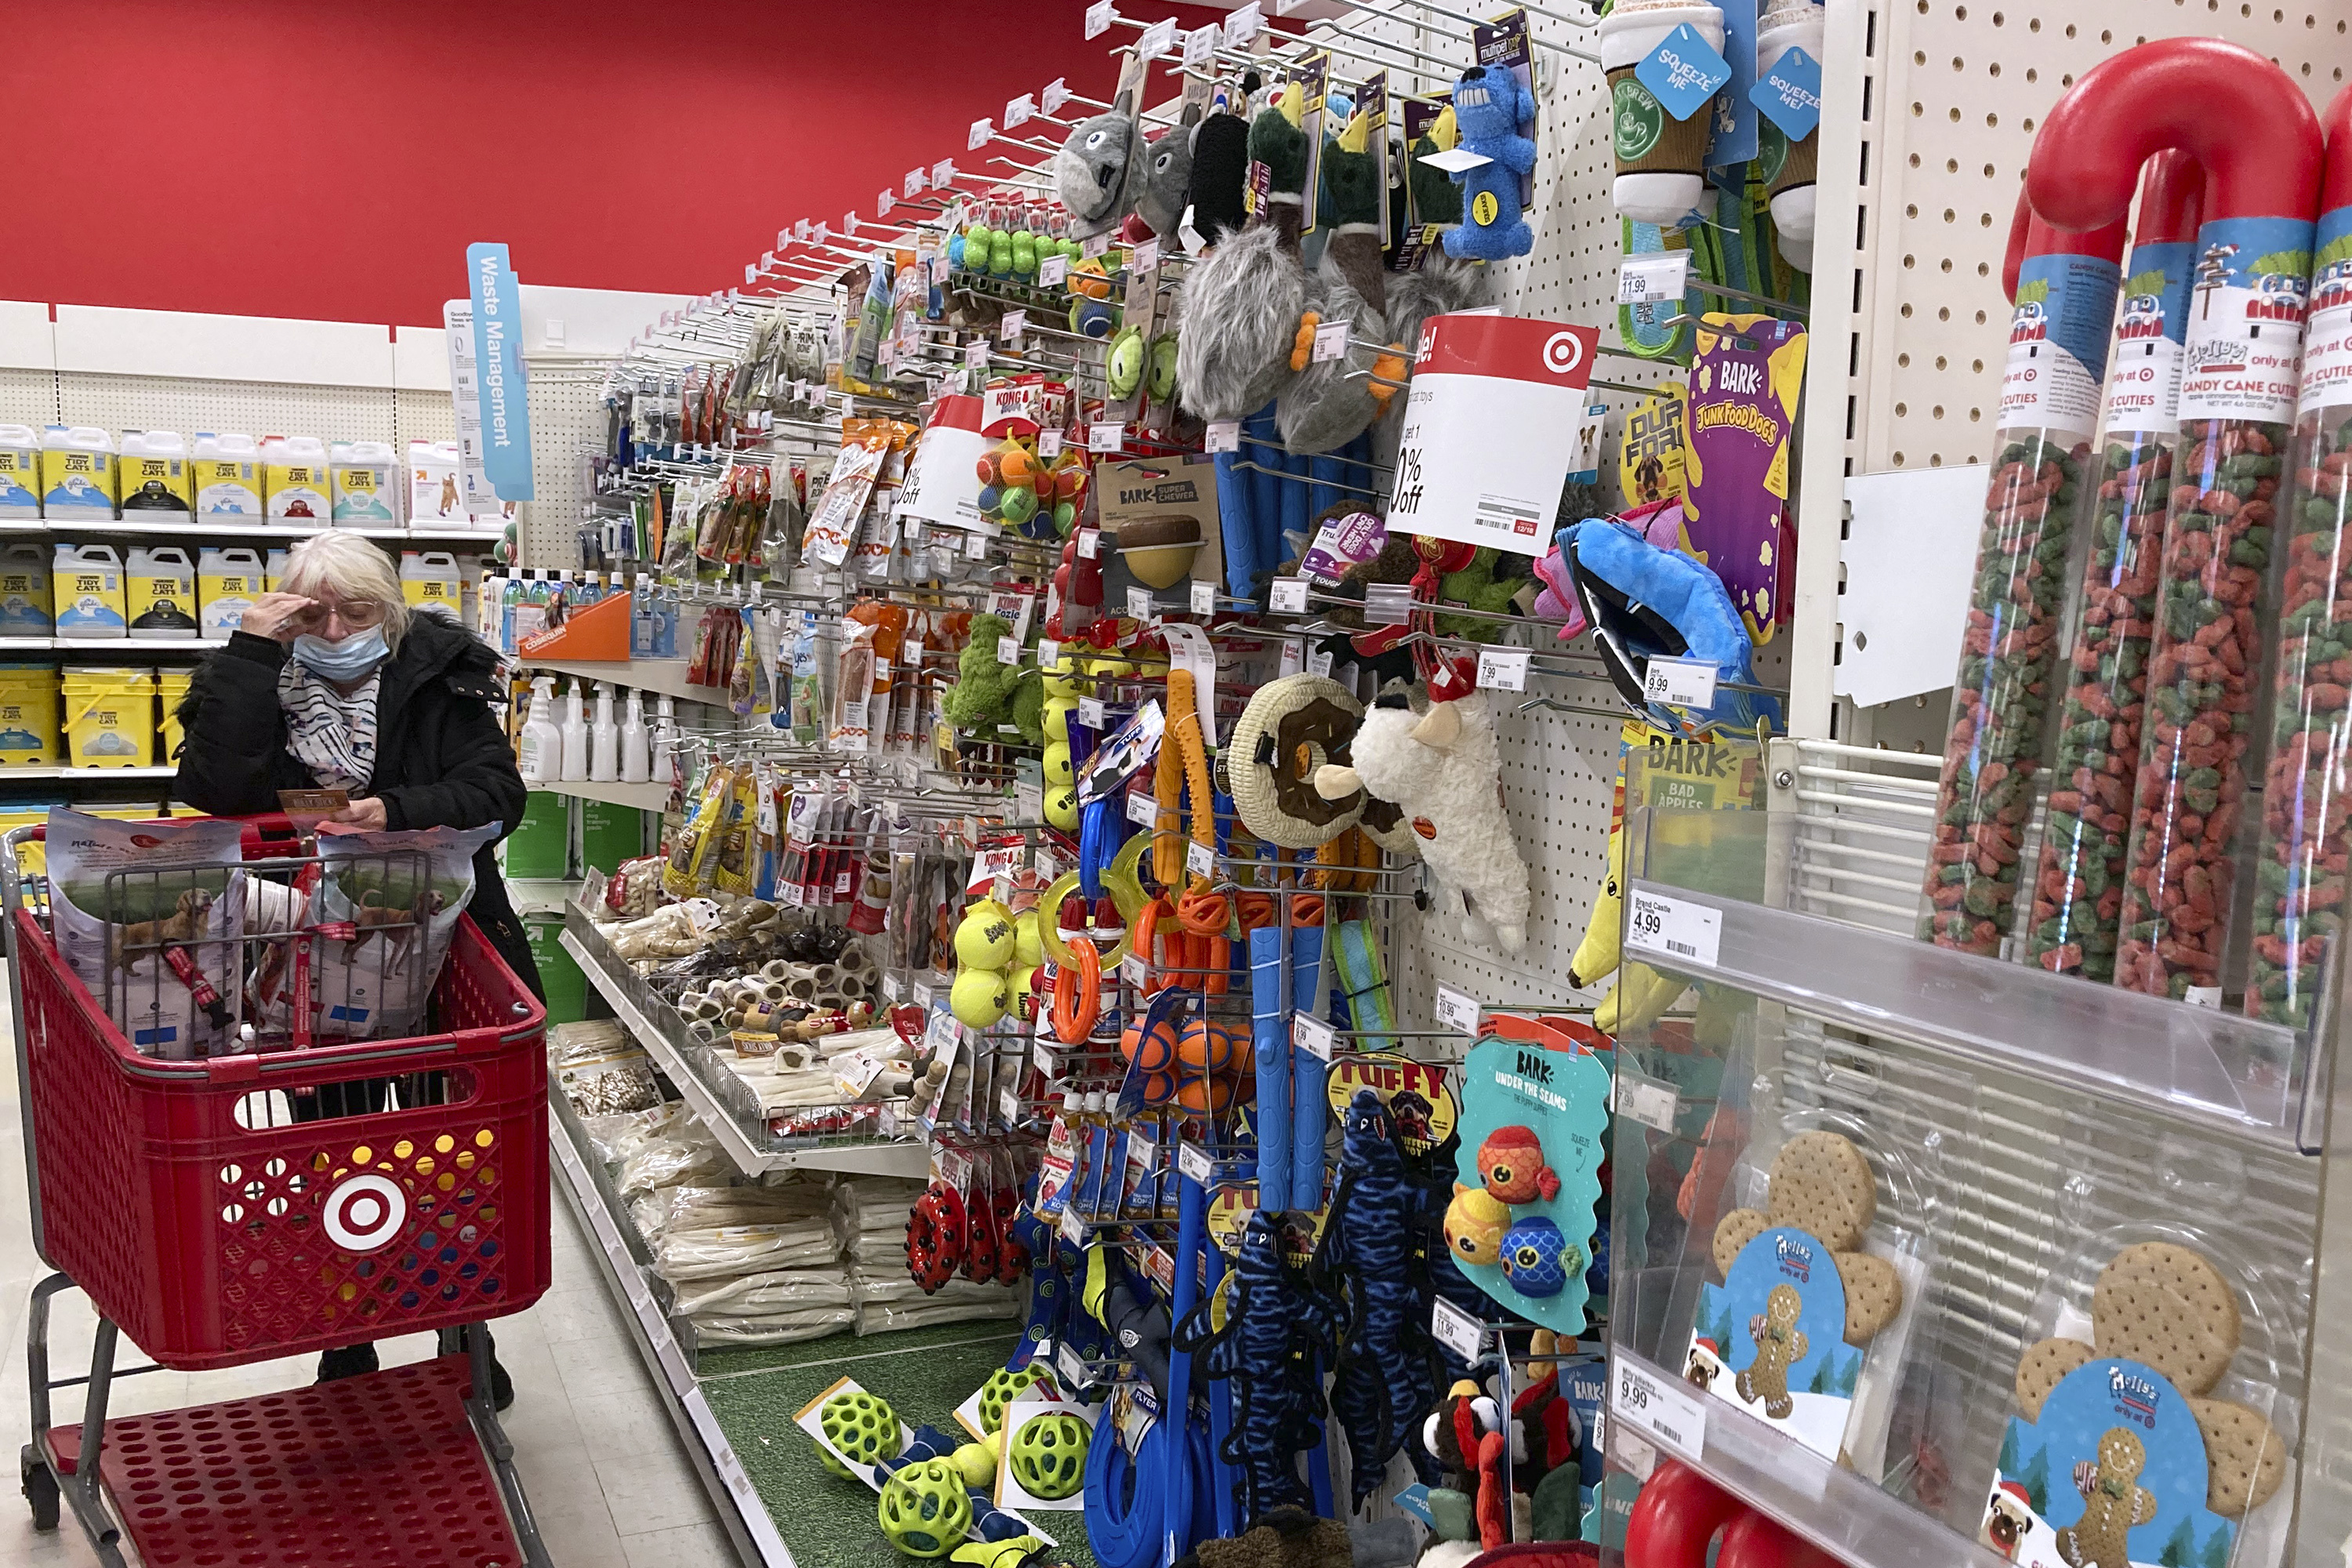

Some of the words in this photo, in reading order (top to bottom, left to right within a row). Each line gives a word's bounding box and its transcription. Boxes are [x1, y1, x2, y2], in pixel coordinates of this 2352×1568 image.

[1658, 48, 1713, 93] SQUEEZE
[1627, 85, 1655, 111] BREW
[1769, 74, 1821, 110] SQUEEZE
[480, 256, 501, 316] Waste
[1623, 279, 1646, 294] 11.99
[2327, 339, 2339, 351] at
[2252, 356, 2278, 368] only
[2281, 358, 2291, 368] at
[485, 321, 511, 448] Management
[1720, 360, 1760, 395] BARK
[2013, 372, 2021, 381] at
[2125, 371, 2136, 380] at
[2183, 379, 2221, 393] CANDY
[2223, 379, 2264, 393] CANE
[996, 390, 1022, 406] KONG
[1420, 390, 1434, 406] toys
[2005, 393, 2037, 405] CUTIES
[2117, 394, 2154, 406] CUTIES
[1630, 398, 1684, 441] DUR
[1625, 424, 1683, 467] FOR
[1390, 447, 1423, 514] 0%
[902, 488, 921, 505] off
[1120, 487, 1153, 505] BARK
[1157, 484, 1186, 495] SUPER
[1158, 491, 1195, 502] CHEWER
[1399, 485, 1424, 514] off
[1516, 524, 1534, 534] 12/18
[524, 626, 568, 652] COSEQUIN
[1482, 666, 1497, 679] 7.99
[1648, 677, 1668, 692] 9.99
[1648, 734, 1730, 779] BARK
[1669, 782, 1695, 798] BAD
[985, 851, 1007, 867] KONG
[1635, 896, 1653, 909] Brand
[1652, 900, 1671, 913] Castle
[1633, 911, 1661, 935] 4.99
[1438, 1001, 1454, 1018] 10.99
[1295, 1027, 1307, 1041] 9.99
[1333, 1051, 1449, 1100] TUFFY
[1516, 1050, 1552, 1085] BARK
[1495, 1069, 1523, 1092] UNDER
[1523, 1080, 1539, 1098] THE
[1538, 1085, 1567, 1112] SEAMS
[1570, 1131, 1591, 1149] SQUEEZE
[1575, 1146, 1584, 1157] ME
[1132, 1196, 1152, 1205] KONG
[1436, 1317, 1454, 1337] 11.99
[1573, 1380, 1602, 1402] BARK
[2111, 1372, 2158, 1400] Molly's
[1135, 1390, 1156, 1411] FLYER
[1621, 1381, 1648, 1410] 9.99
